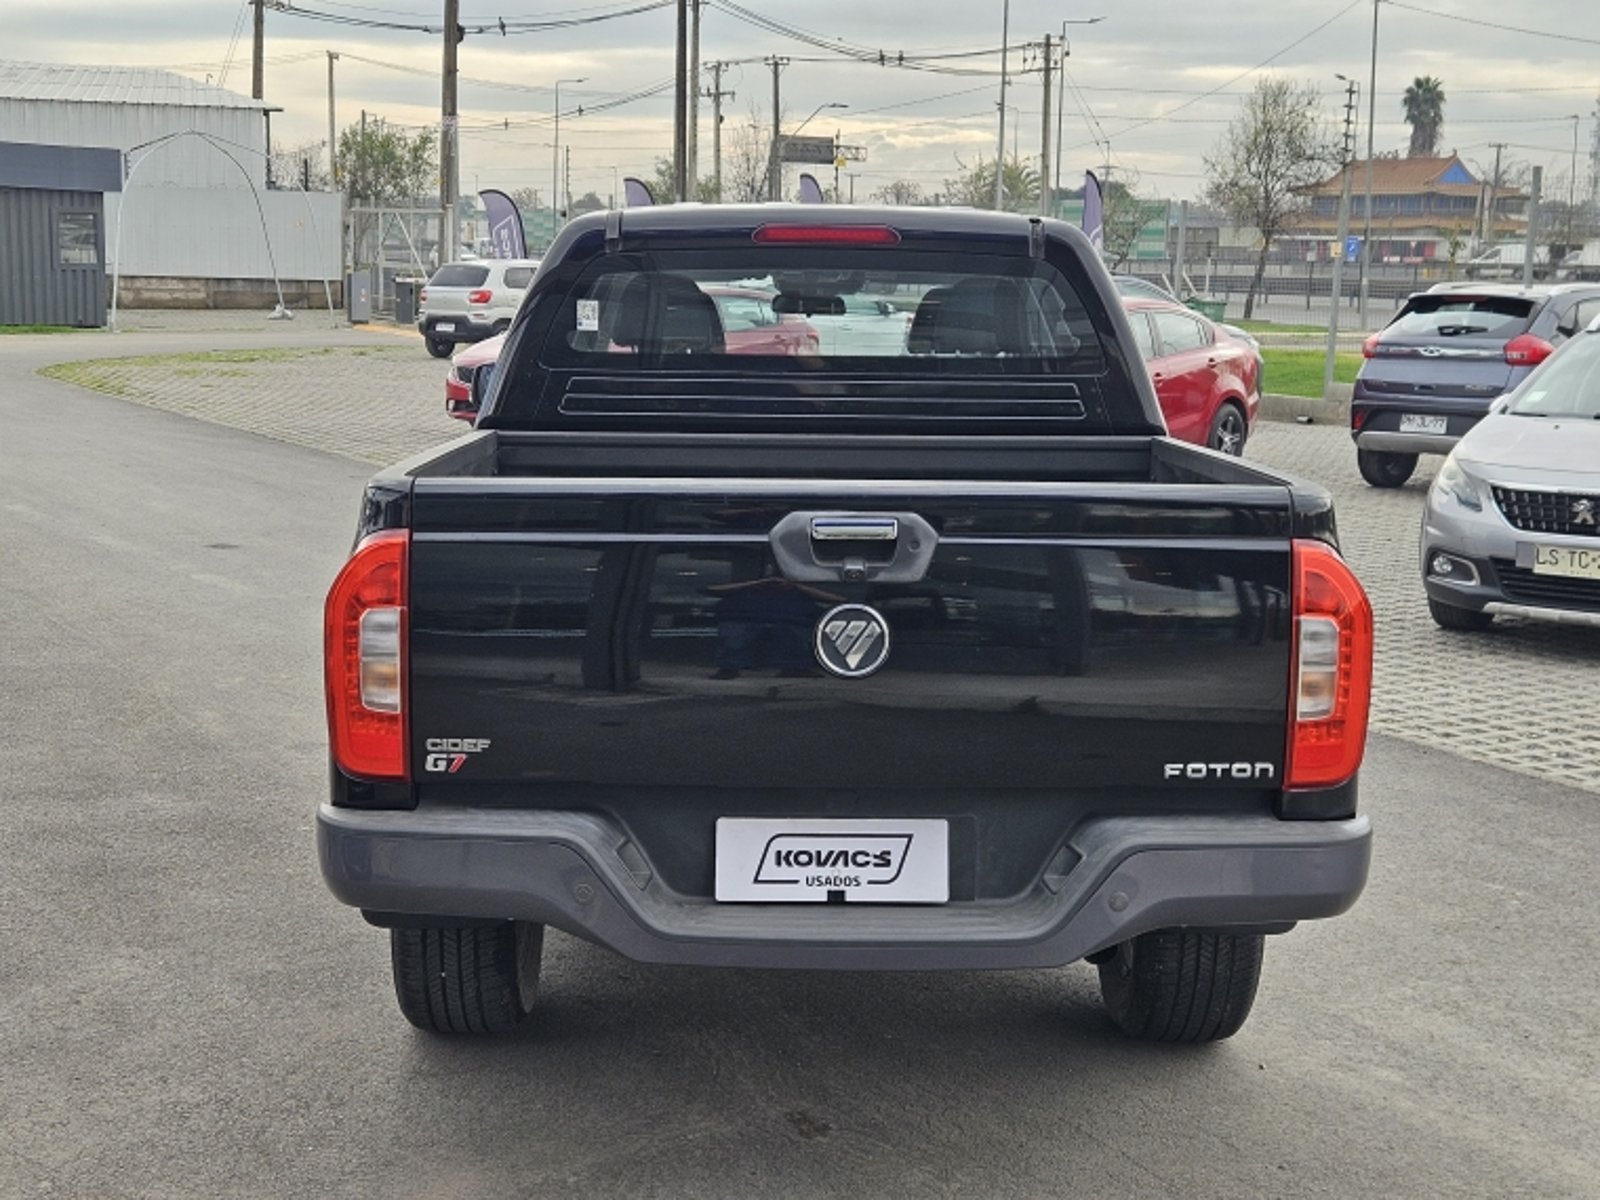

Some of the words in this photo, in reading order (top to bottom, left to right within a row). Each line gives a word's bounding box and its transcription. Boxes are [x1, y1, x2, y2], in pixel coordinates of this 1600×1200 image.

[425, 738, 491, 752] CIDEF
[425, 753, 467, 773] G7
[1164, 763, 1275, 779] FOTON
[775, 850, 892, 868] KOVACS
[805, 876, 862, 887] USADOS
